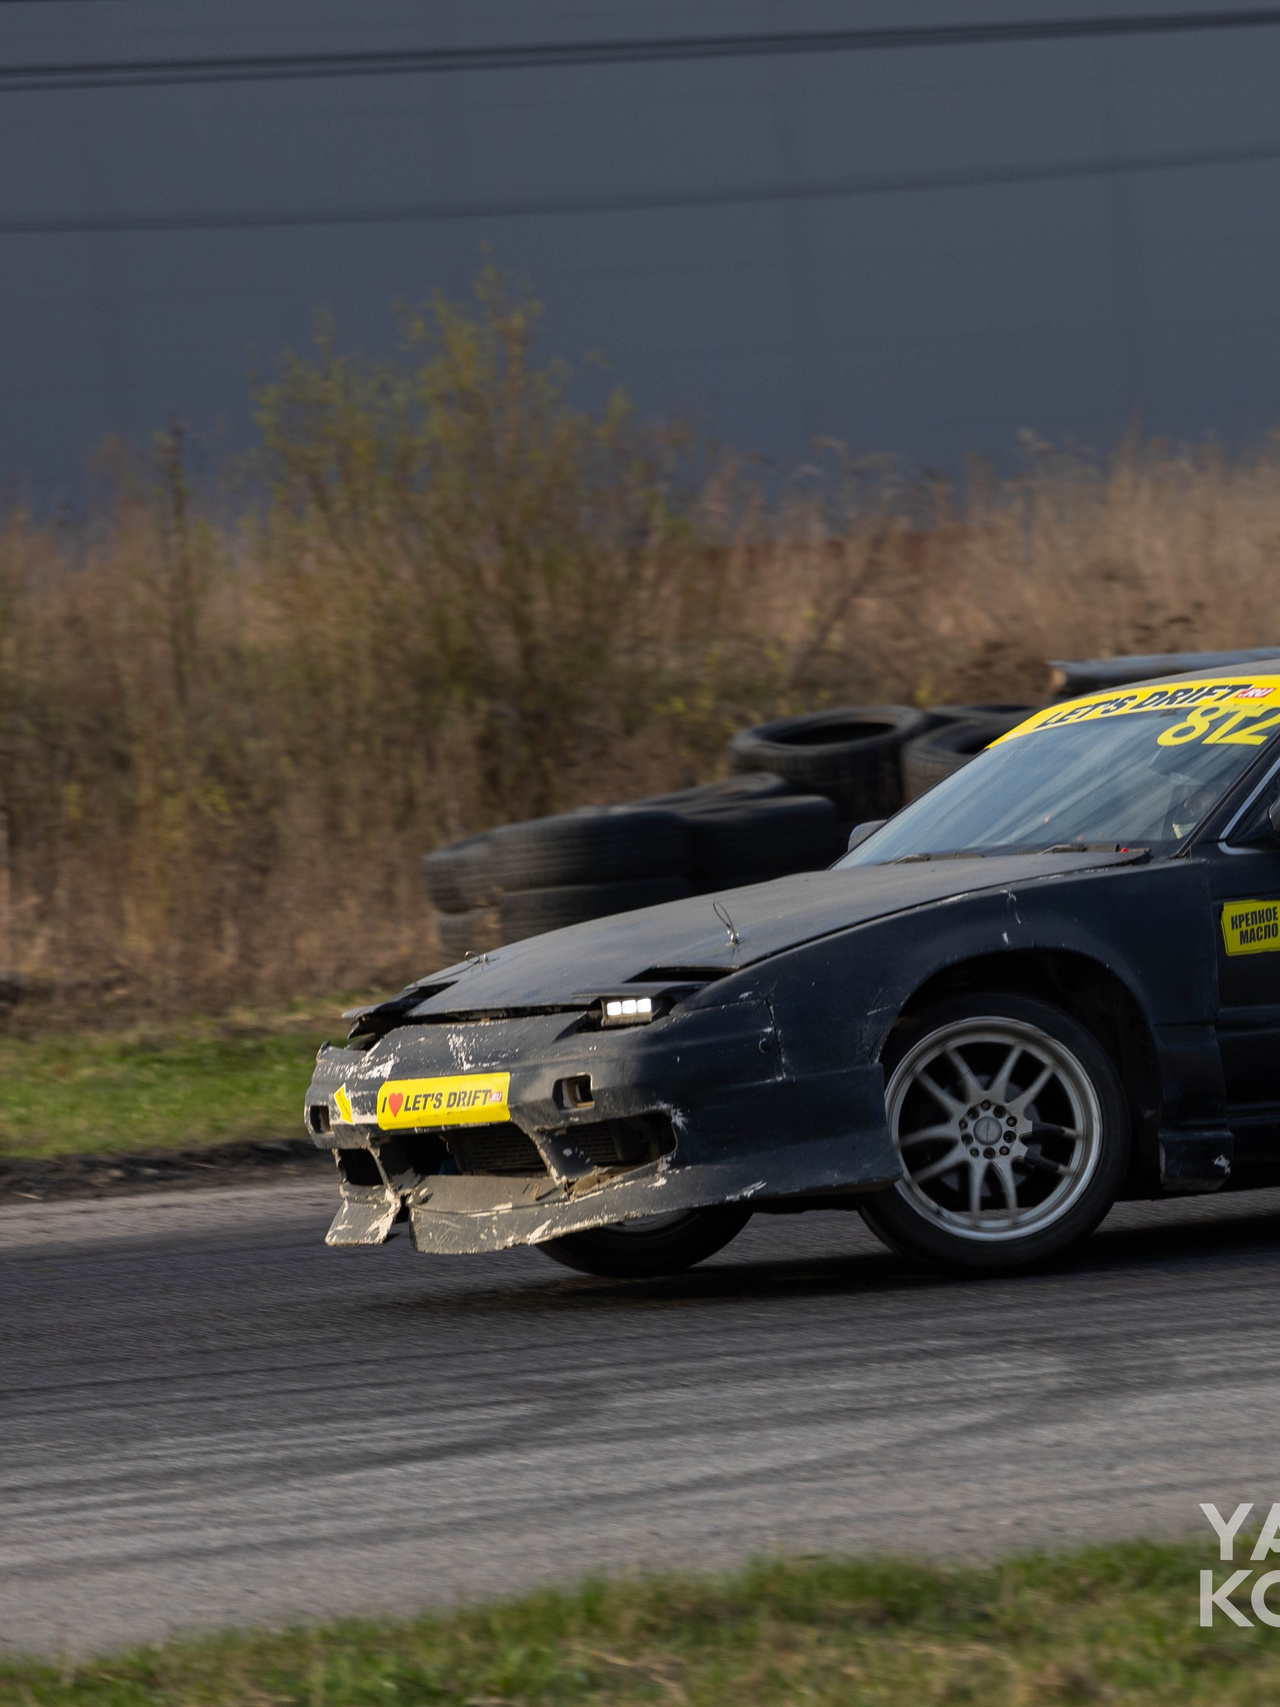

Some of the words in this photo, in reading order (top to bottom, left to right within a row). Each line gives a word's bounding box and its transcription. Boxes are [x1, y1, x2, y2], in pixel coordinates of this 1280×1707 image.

[1033, 694, 1138, 730] LET'S
[1230, 906, 1279, 931] КРЕПКОЕ
[1239, 922, 1279, 946] МАСЛО
[381, 1096, 388, 1114] I
[403, 1092, 442, 1112] LET'S
